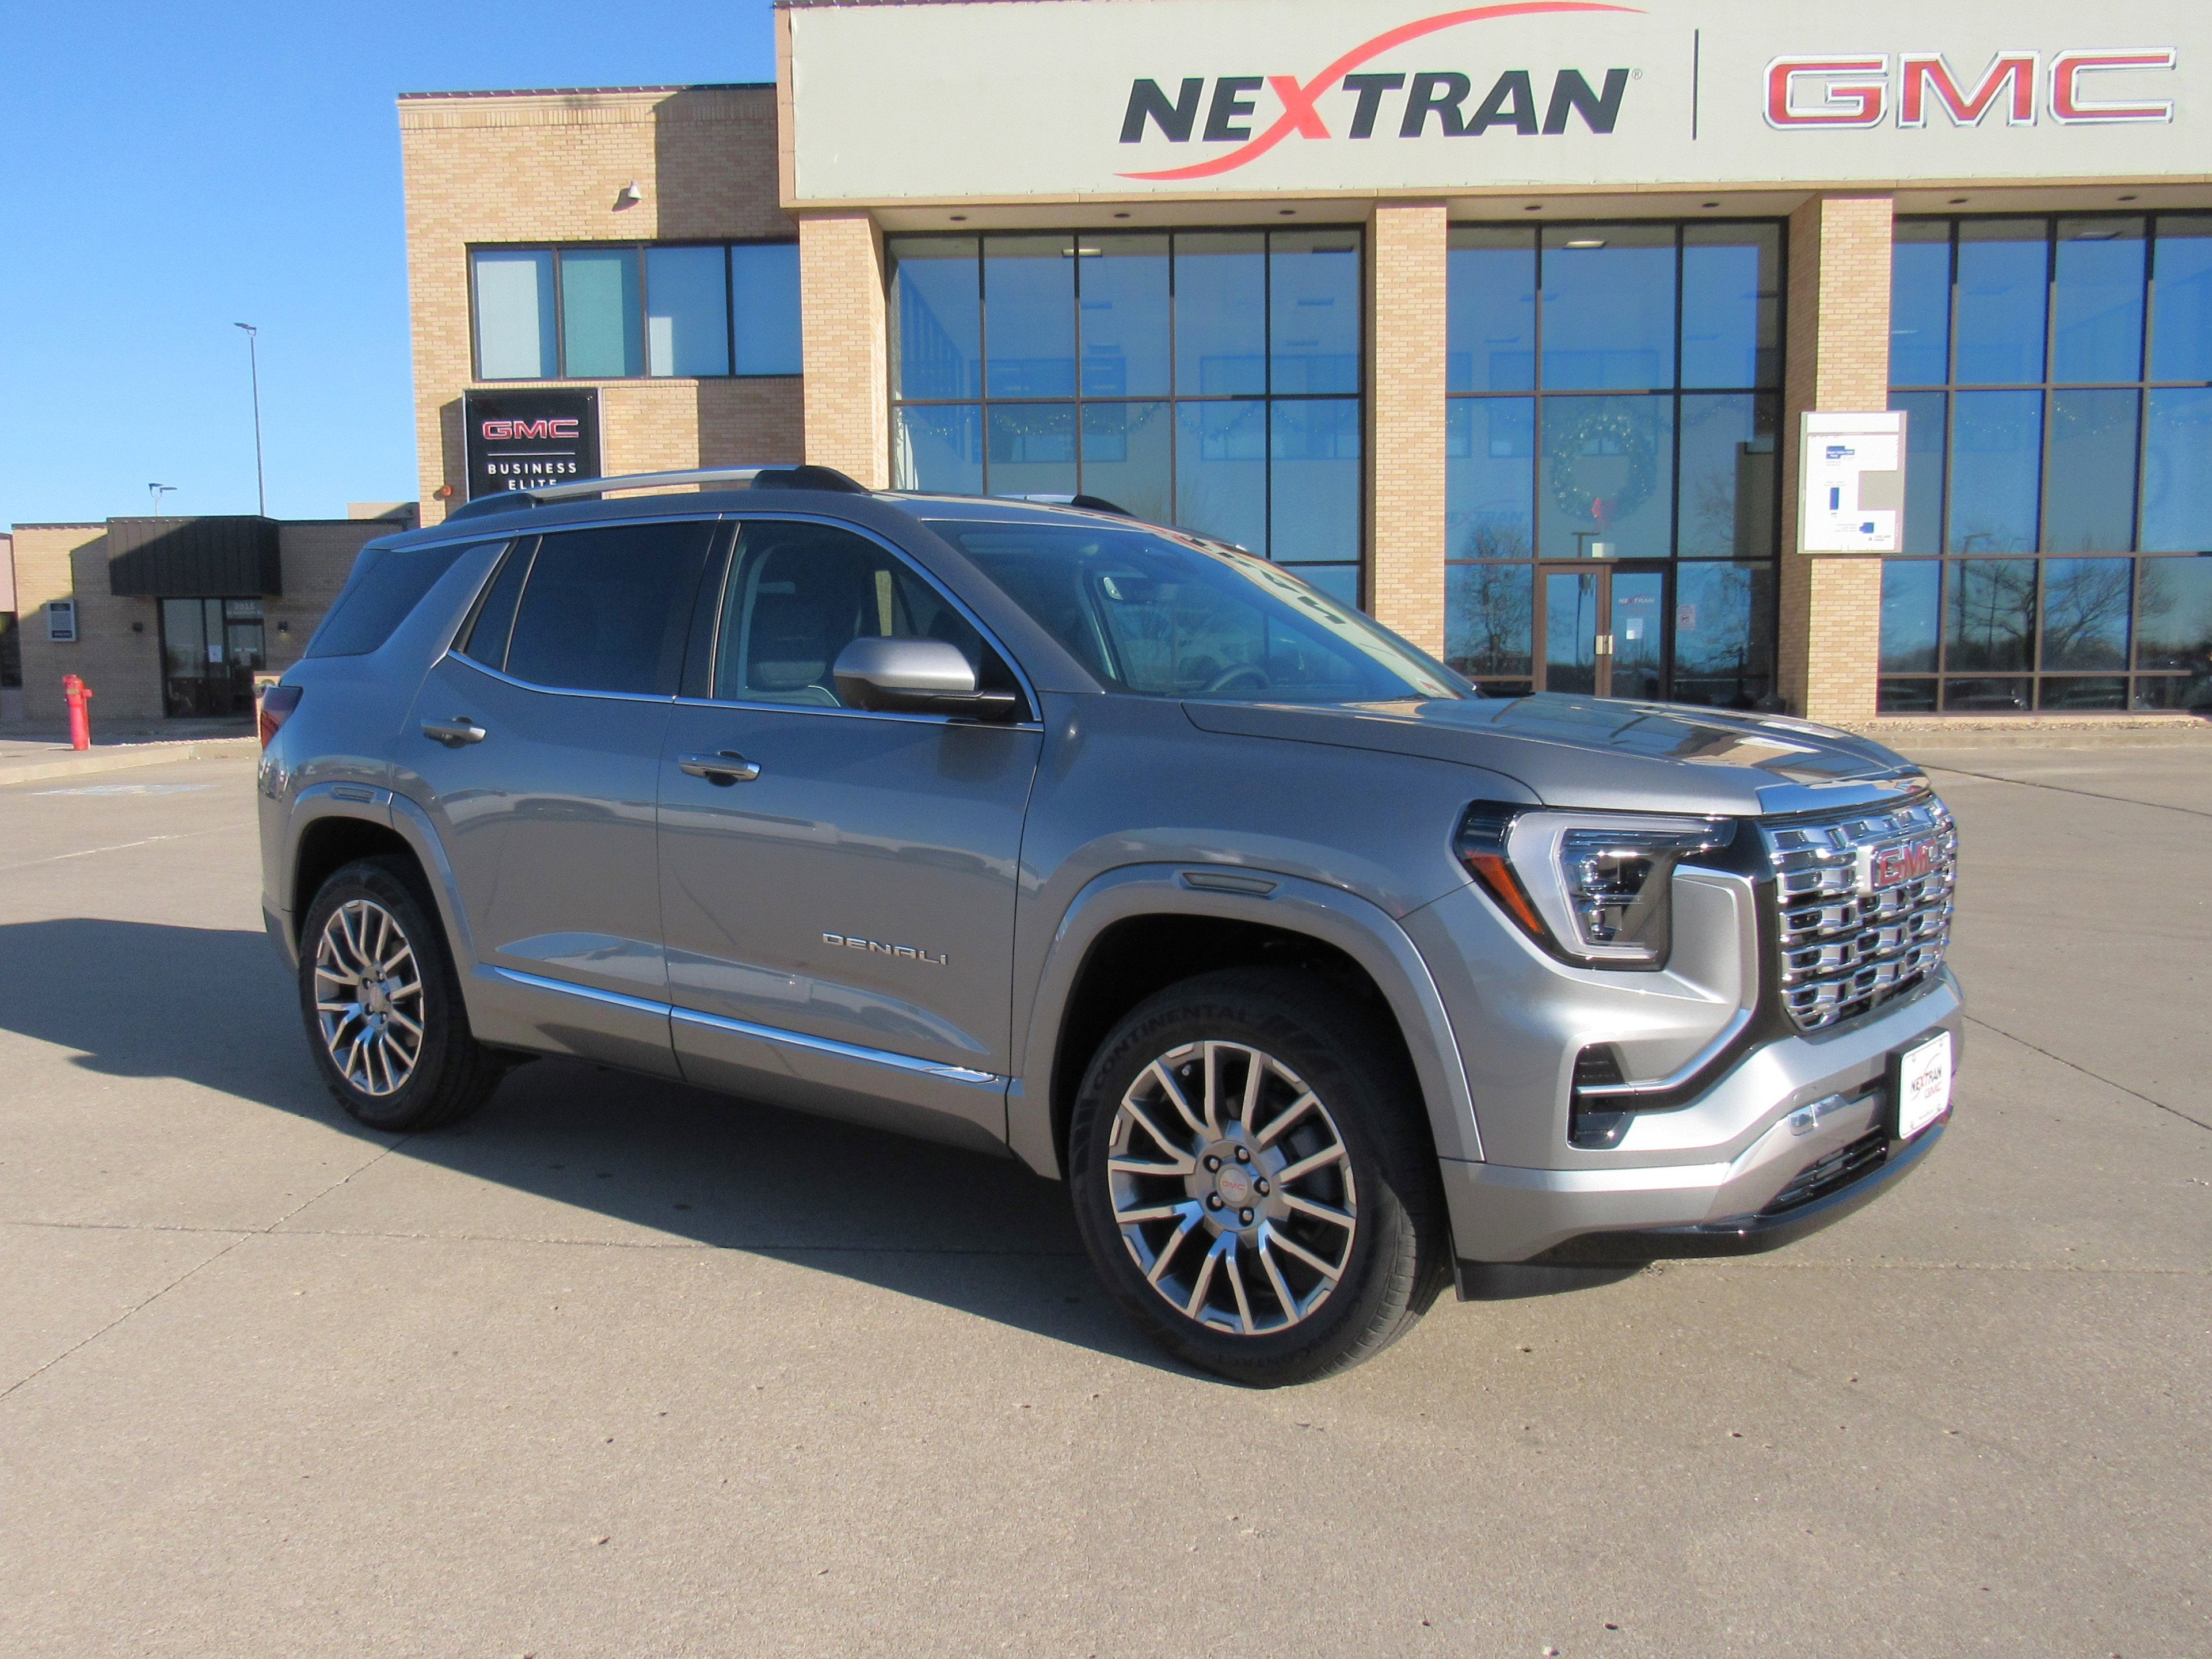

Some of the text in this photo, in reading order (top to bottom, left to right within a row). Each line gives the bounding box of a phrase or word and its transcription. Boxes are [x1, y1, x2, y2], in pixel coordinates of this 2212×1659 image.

[1761, 47, 2177, 130] GMC
[1118, 68, 1630, 144] NEXTRAN
[482, 420, 579, 440] GMC
[488, 463, 577, 474] BUSINESS
[1446, 511, 1525, 522] EXTRAN
[1879, 838, 1948, 885] GMC
[823, 932, 948, 966] DENALI
[1094, 1003, 1250, 1091] CONTINENTAL
[1910, 1064, 1942, 1094] NEXTRAN
[1924, 1081, 1942, 1099] GMC
[1222, 1180, 1245, 1190] GMC
